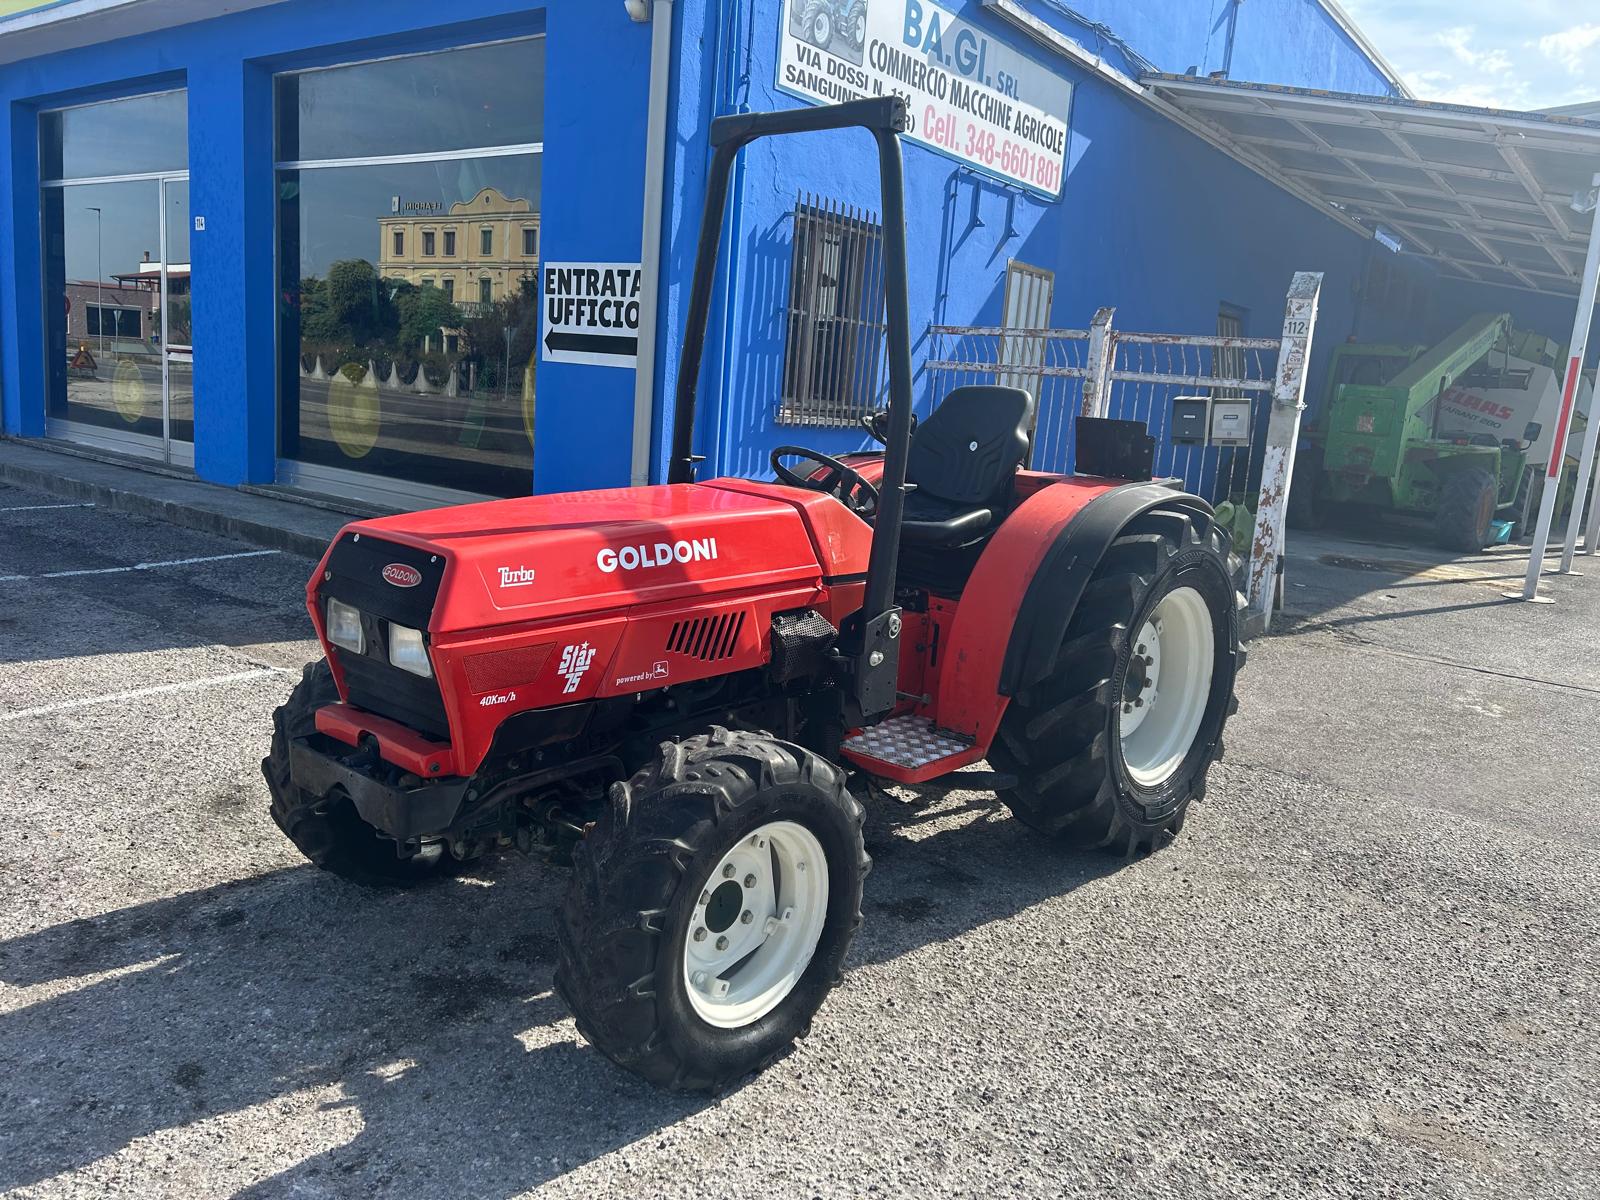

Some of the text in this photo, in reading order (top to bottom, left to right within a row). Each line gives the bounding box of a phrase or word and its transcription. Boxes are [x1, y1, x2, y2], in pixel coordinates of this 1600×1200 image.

[903, 0, 1019, 101] BA.GI. SRL
[796, 43, 821, 71] VIA
[827, 58, 869, 91] DOSSI
[869, 39, 1063, 155] COMMERCIO MACCHINE AGRICOLE
[923, 104, 1060, 191] Cell. 348-6601801
[545, 268, 641, 297] ENTRATA
[548, 297, 640, 329] UFFICIO
[1288, 321, 1305, 334] 112
[597, 538, 717, 572] GOLDONI
[384, 566, 417, 583] GOLDONI
[498, 565, 534, 587] Turbo
[558, 645, 596, 674] Star
[563, 672, 583, 694] 75
[616, 671, 653, 686] powered by
[479, 691, 516, 707] 40Km/h
